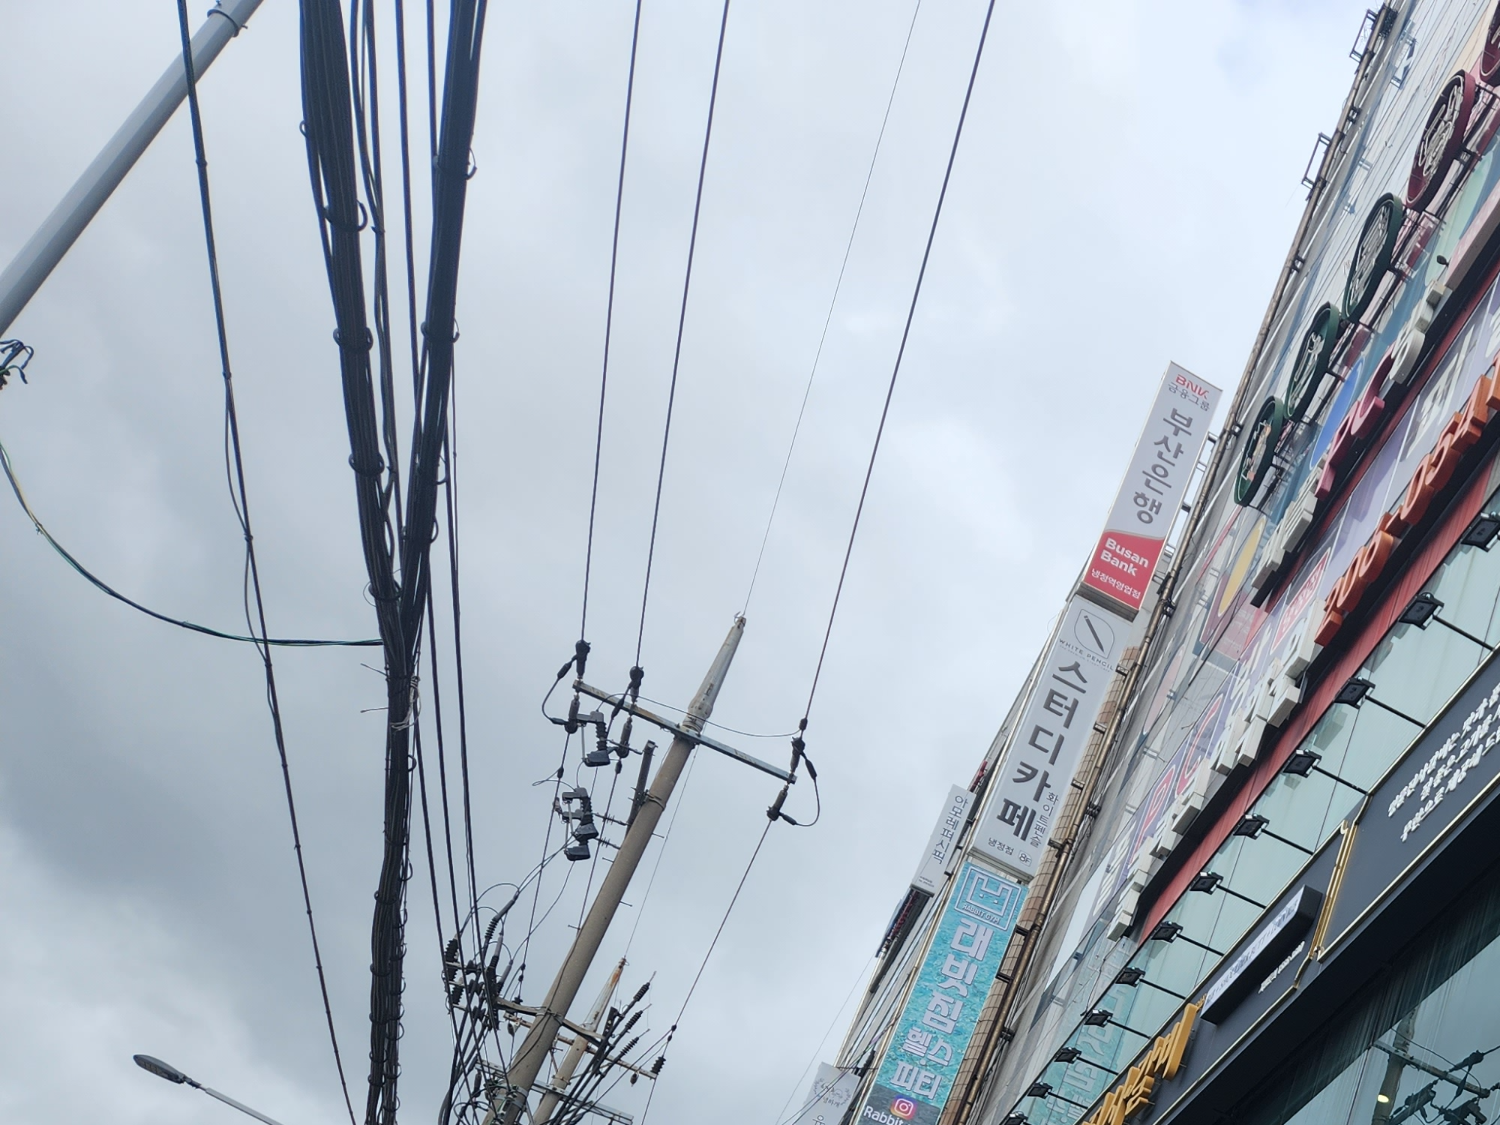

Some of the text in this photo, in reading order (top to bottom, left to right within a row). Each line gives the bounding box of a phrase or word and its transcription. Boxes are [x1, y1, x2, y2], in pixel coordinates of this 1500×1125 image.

[1168, 382, 1210, 413] 금융그룹
[1175, 374, 1209, 400] BNK
[1133, 407, 1194, 525] 부산은행
[1100, 548, 1138, 578] Bank
[1104, 536, 1150, 570] Busan
[1090, 566, 1142, 600] 냉정역영업점
[1059, 638, 1084, 656] WHITE
[1086, 653, 1115, 672] PENCIL
[997, 660, 1088, 842] 스터디카페
[931, 795, 969, 866] 아모레퍼시픽
[1030, 791, 1059, 849] 화이트펜슬
[987, 836, 1015, 856] 냉정점
[922, 917, 994, 1034] 래빗짐
[901, 1025, 954, 1067] 헬스
[890, 1061, 943, 1100] 피티
